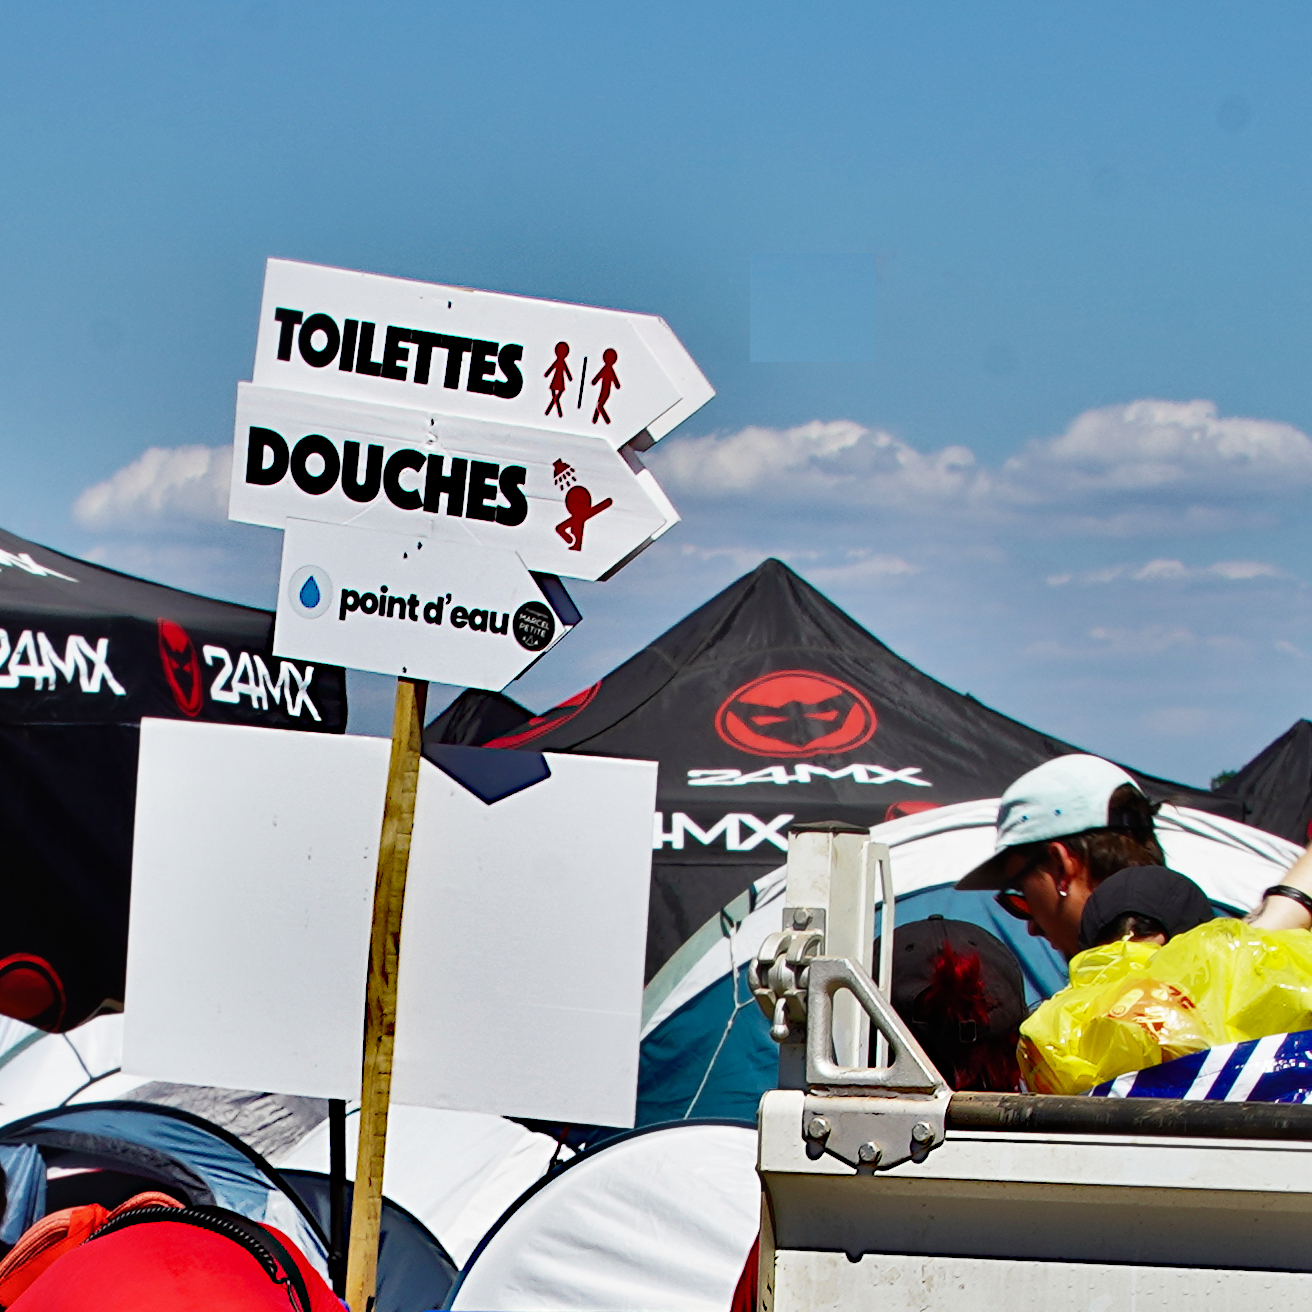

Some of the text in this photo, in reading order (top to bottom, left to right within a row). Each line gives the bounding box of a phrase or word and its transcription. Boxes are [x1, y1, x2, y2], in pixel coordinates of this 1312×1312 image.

[274, 307, 524, 399] TOILETTES
[245, 426, 529, 527] DOUCHES
[339, 584, 510, 636] point d'eau
[202, 644, 323, 722] 24MX
[687, 764, 933, 787] 24MX
